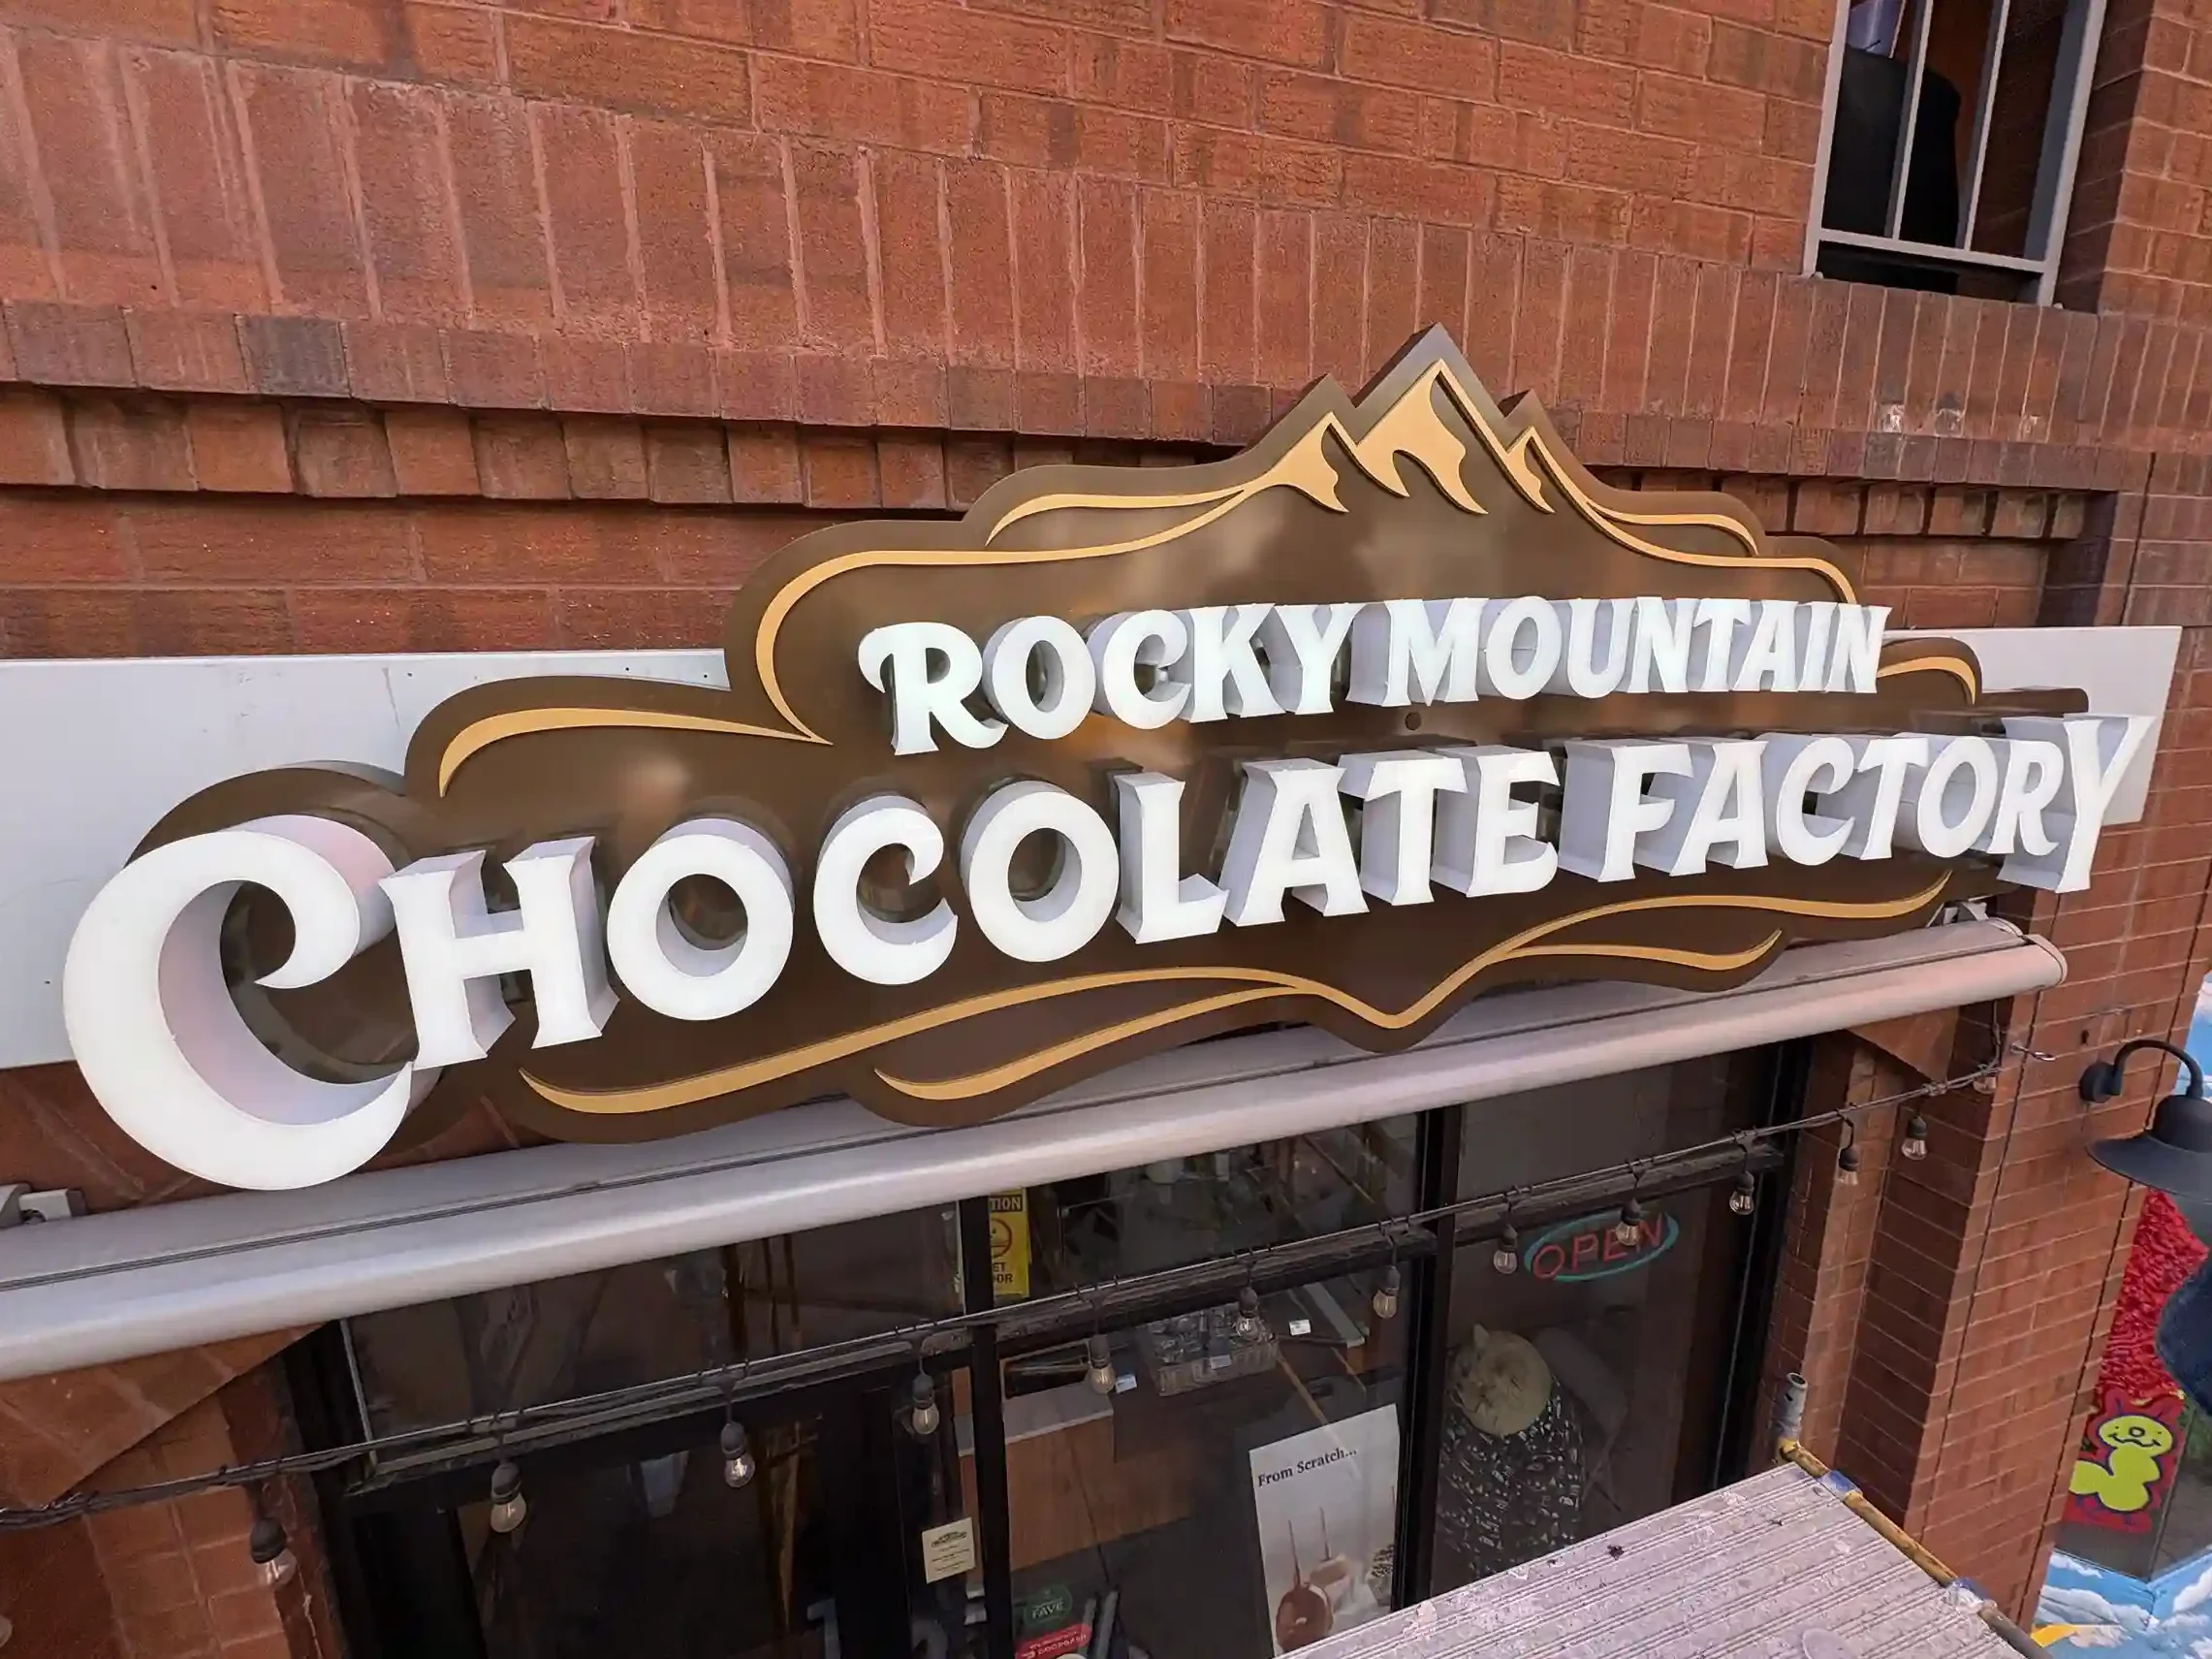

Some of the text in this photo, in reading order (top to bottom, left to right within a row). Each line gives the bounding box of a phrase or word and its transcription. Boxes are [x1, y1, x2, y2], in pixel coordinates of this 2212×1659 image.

[858, 596, 1891, 755] ROCKY MOUNTAIN
[63, 716, 2156, 1192] CHOCOLATE FACTORY
[991, 1196, 1022, 1211] TION
[993, 1262, 1005, 1273] ET
[1257, 1447, 1358, 1487] From Scratch...
